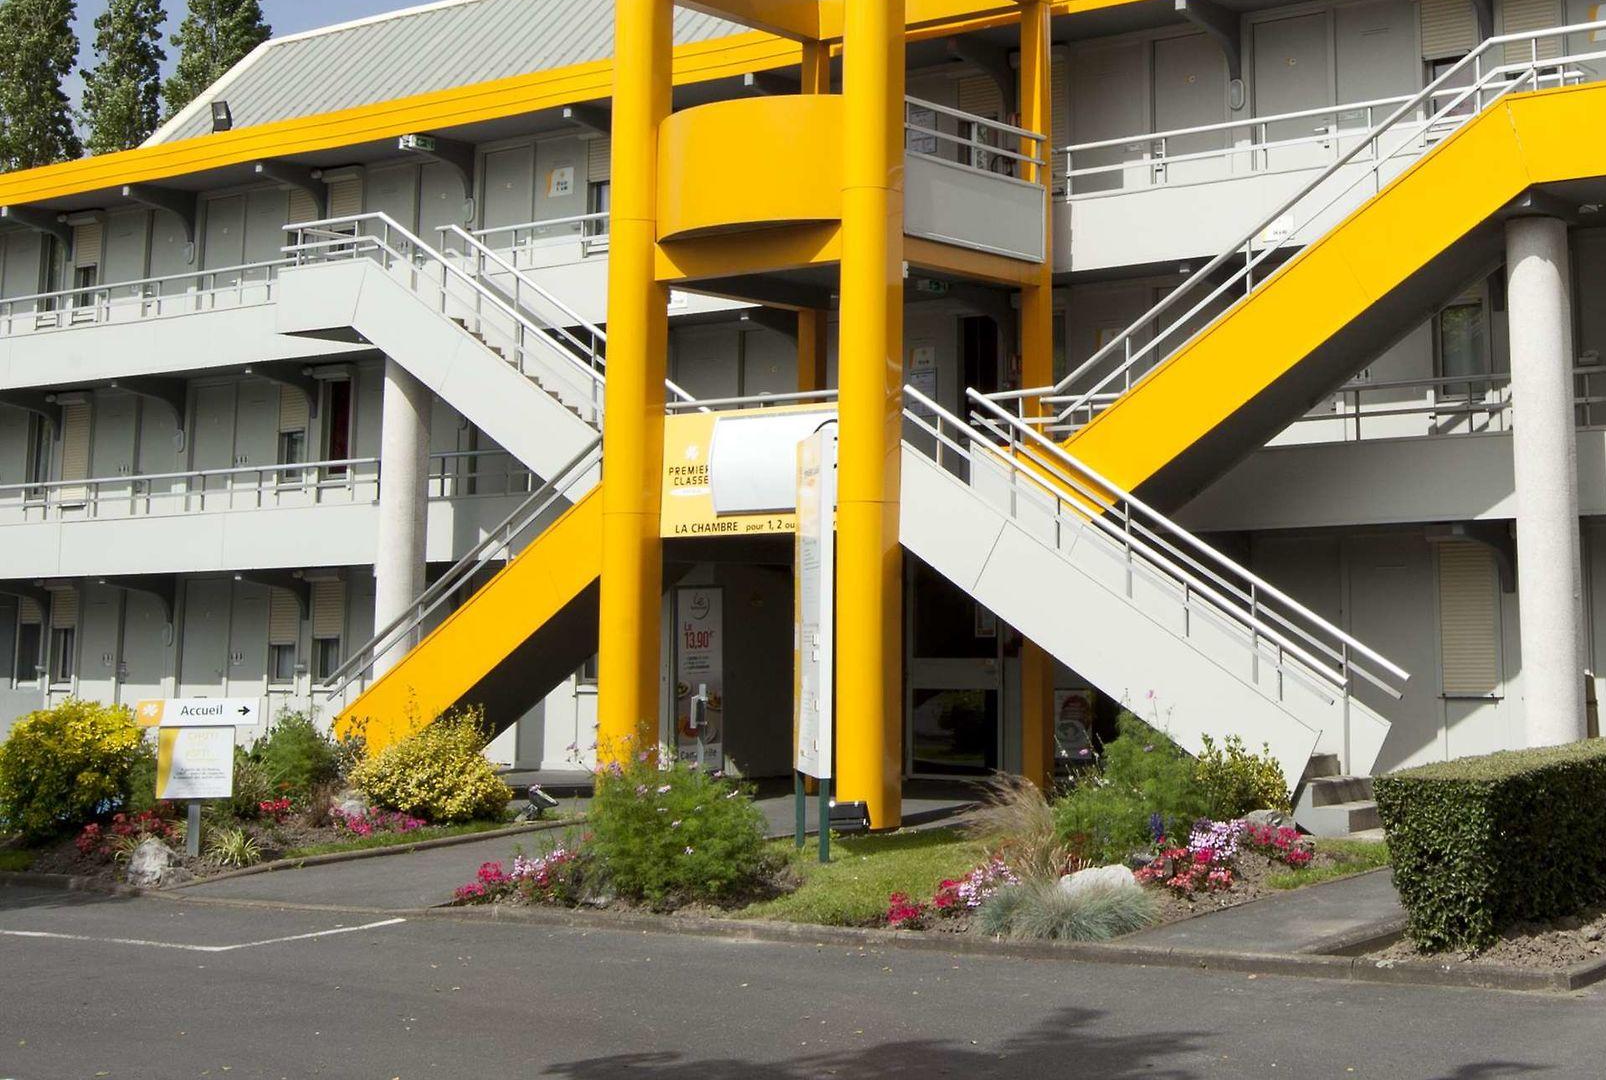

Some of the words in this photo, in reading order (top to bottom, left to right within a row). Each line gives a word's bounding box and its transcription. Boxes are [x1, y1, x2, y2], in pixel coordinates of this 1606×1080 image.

[668, 464, 709, 476] PREMIE
[674, 475, 709, 486] CLASSE
[675, 523, 688, 534] LA
[691, 521, 738, 533] CHAMBRE
[745, 523, 764, 533] pour
[776, 519, 782, 530] 2
[784, 522, 796, 530] ou
[180, 705, 223, 716] Accueil
